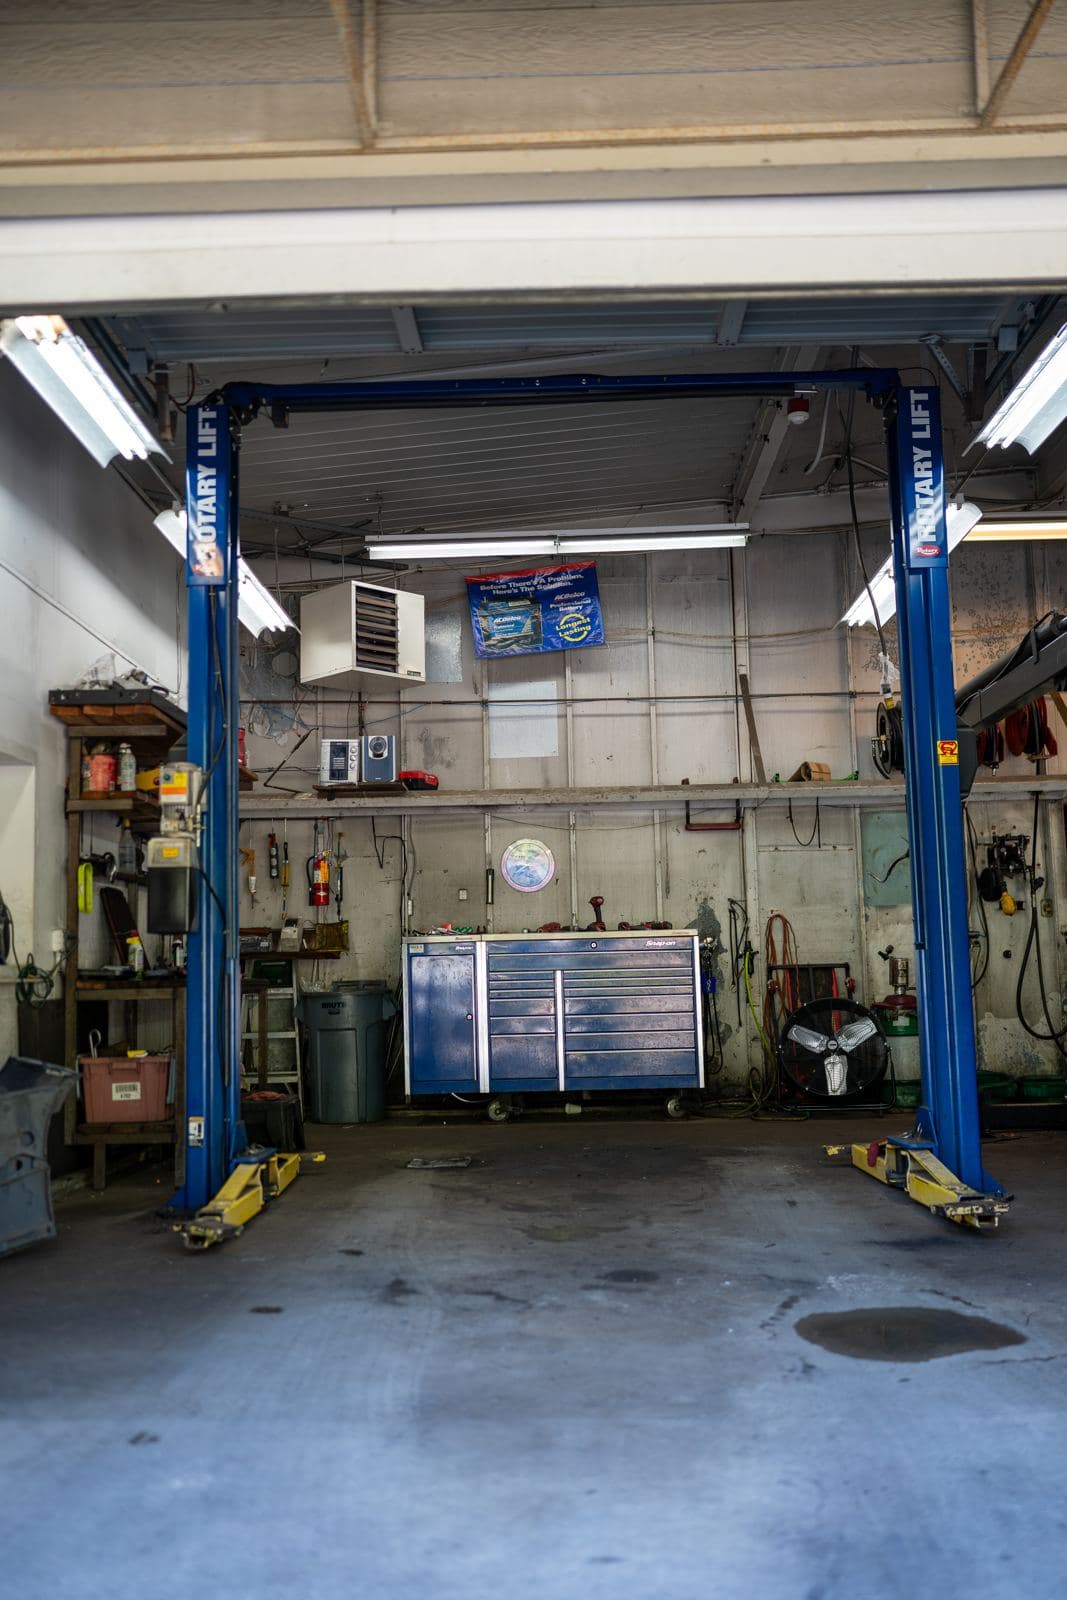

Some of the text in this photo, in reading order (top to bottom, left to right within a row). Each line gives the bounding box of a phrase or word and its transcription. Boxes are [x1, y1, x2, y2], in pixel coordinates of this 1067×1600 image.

[197, 408, 217, 456] LIFT
[911, 389, 937, 542] ROTARY LIFT
[480, 583, 508, 591] Before
[492, 586, 518, 595] Here's
[554, 591, 586, 600] ACDelco
[556, 617, 591, 631] Longest
[559, 625, 592, 638] Lasting
